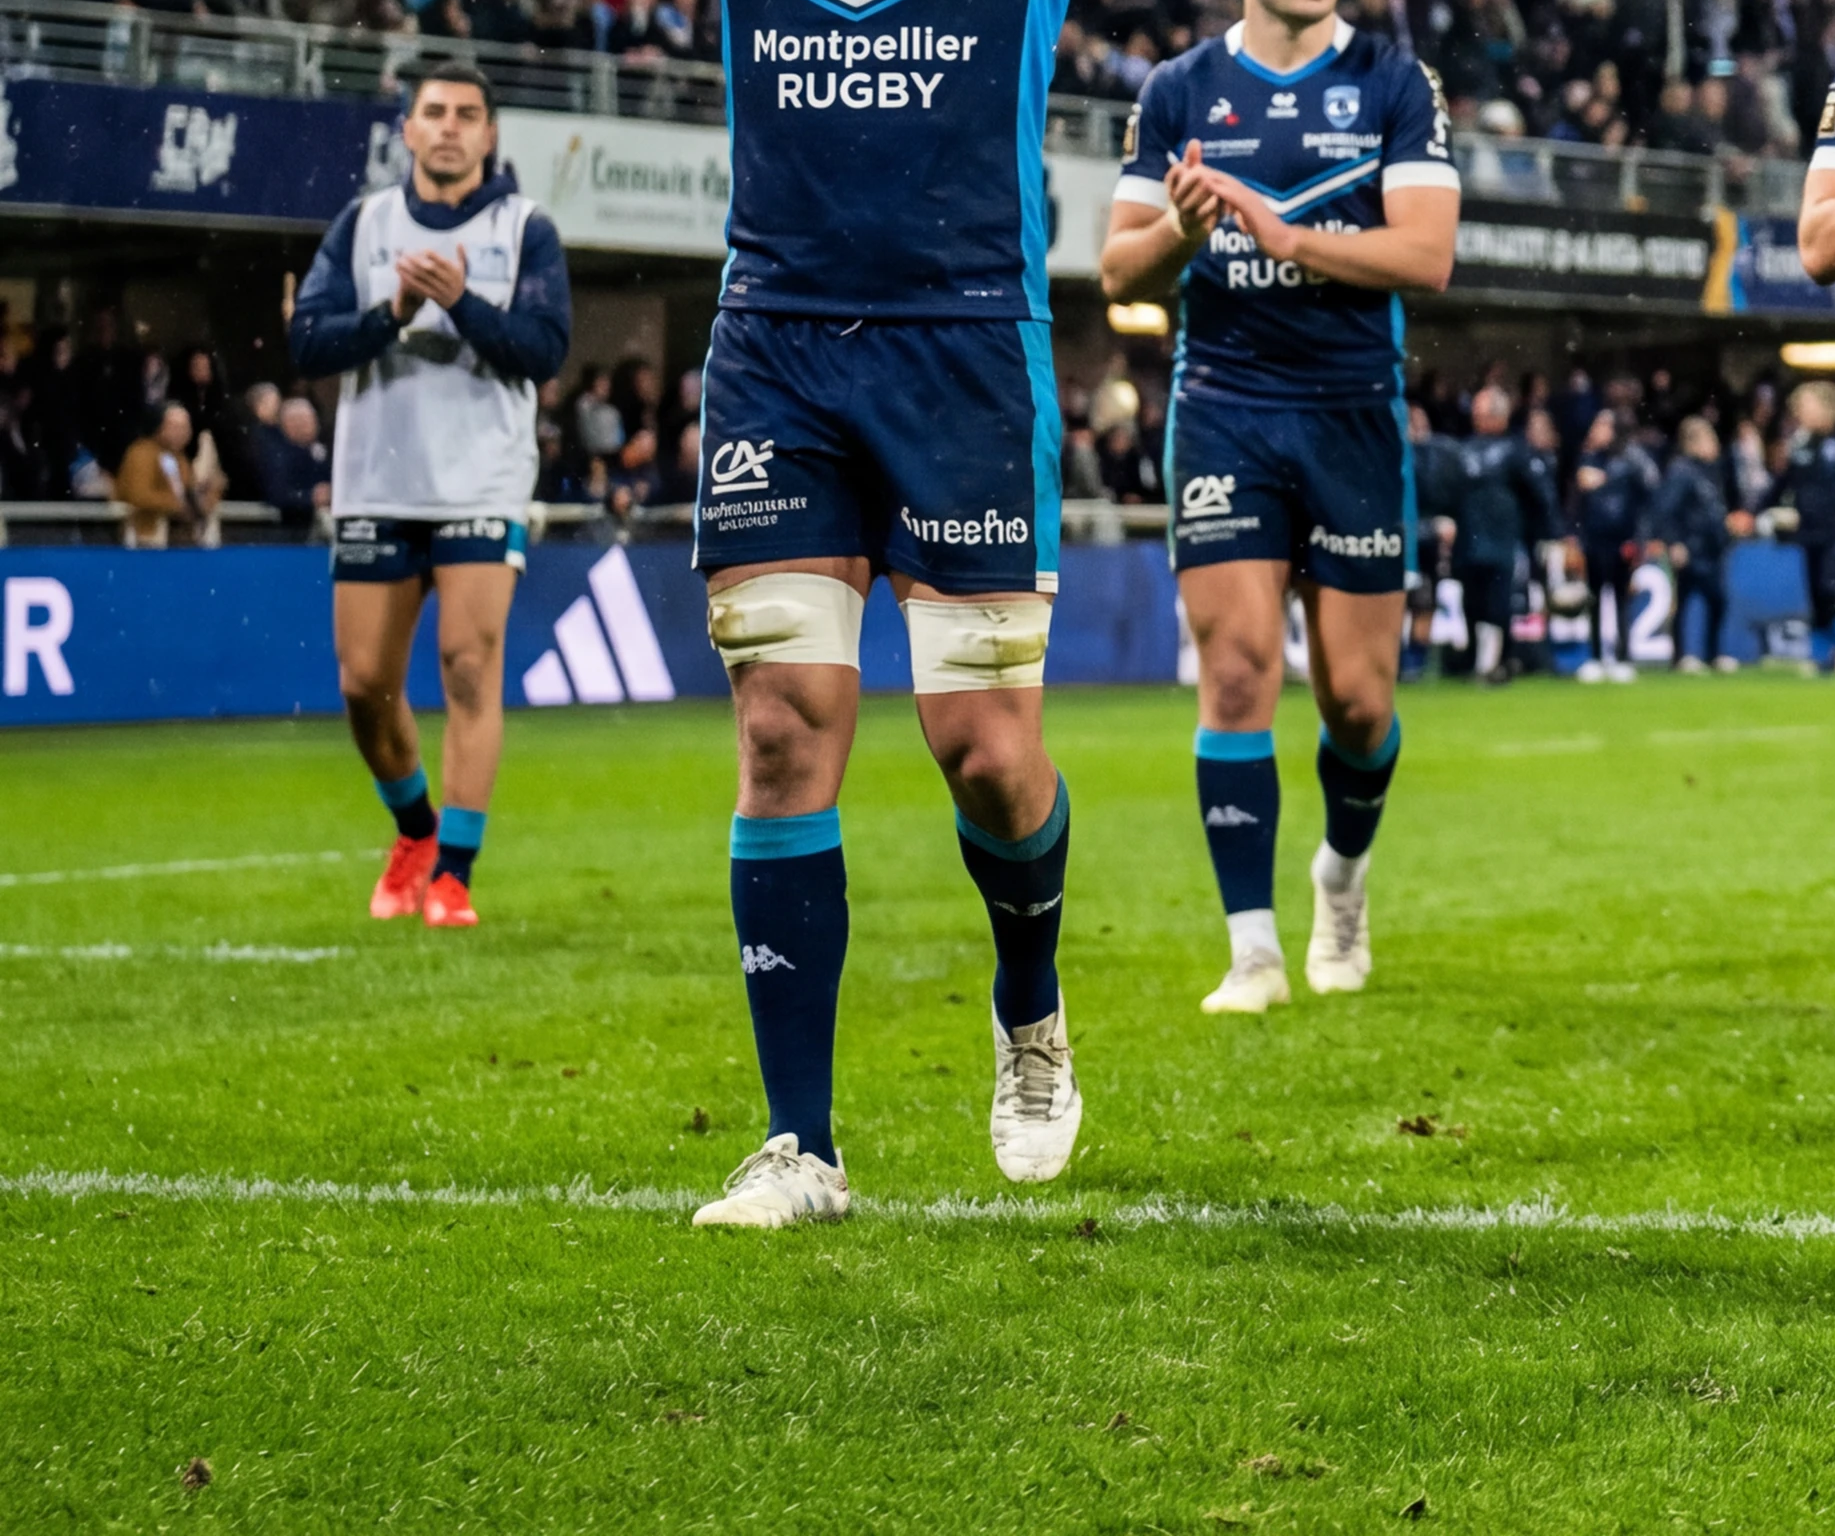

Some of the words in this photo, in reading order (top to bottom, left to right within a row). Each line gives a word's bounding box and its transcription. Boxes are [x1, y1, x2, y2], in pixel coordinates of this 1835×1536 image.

[754, 26, 978, 68] Montpellier
[778, 72, 945, 109] RUGBY
[3, 575, 76, 697] R
